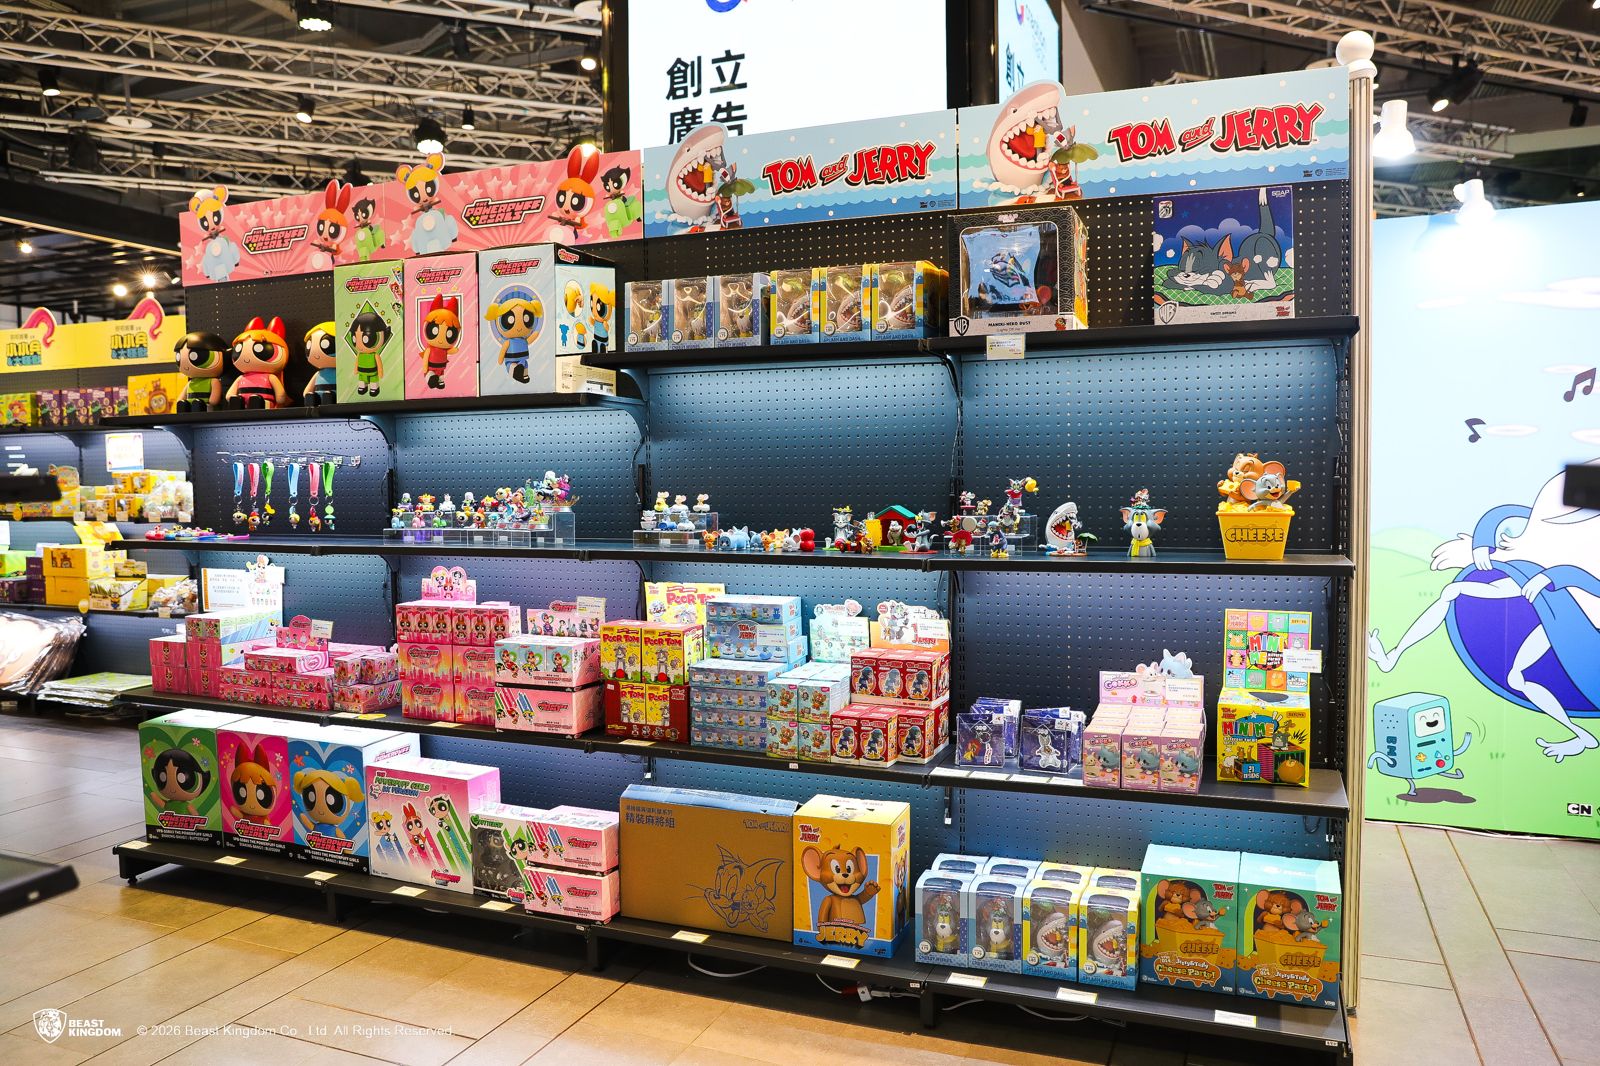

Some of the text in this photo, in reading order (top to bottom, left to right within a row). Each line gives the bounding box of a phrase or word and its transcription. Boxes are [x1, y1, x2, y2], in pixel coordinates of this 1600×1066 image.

[666, 50, 747, 100] 創立
[1108, 103, 1324, 162] TOM and JERRY
[763, 142, 936, 195] TOM and JERRY
[465, 199, 541, 217] POWERPUFF
[480, 211, 522, 224] GIRLS
[244, 228, 306, 244] POWERPUFF
[256, 238, 290, 251] GIRLS
[1225, 528, 1284, 542] CHEESE
[1249, 634, 1284, 652] MINI
[1249, 651, 1267, 664] ME
[1222, 721, 1274, 737] MINI ME
[1568, 804, 1592, 815] CN
[800, 834, 820, 842] JERRY
[816, 926, 869, 950] JERRY
[1180, 943, 1220, 954] CHEESE
[1280, 954, 1321, 967] CHEESE
[1156, 964, 1216, 980] Cheese Party!
[1254, 977, 1317, 993] Cheese Party!
